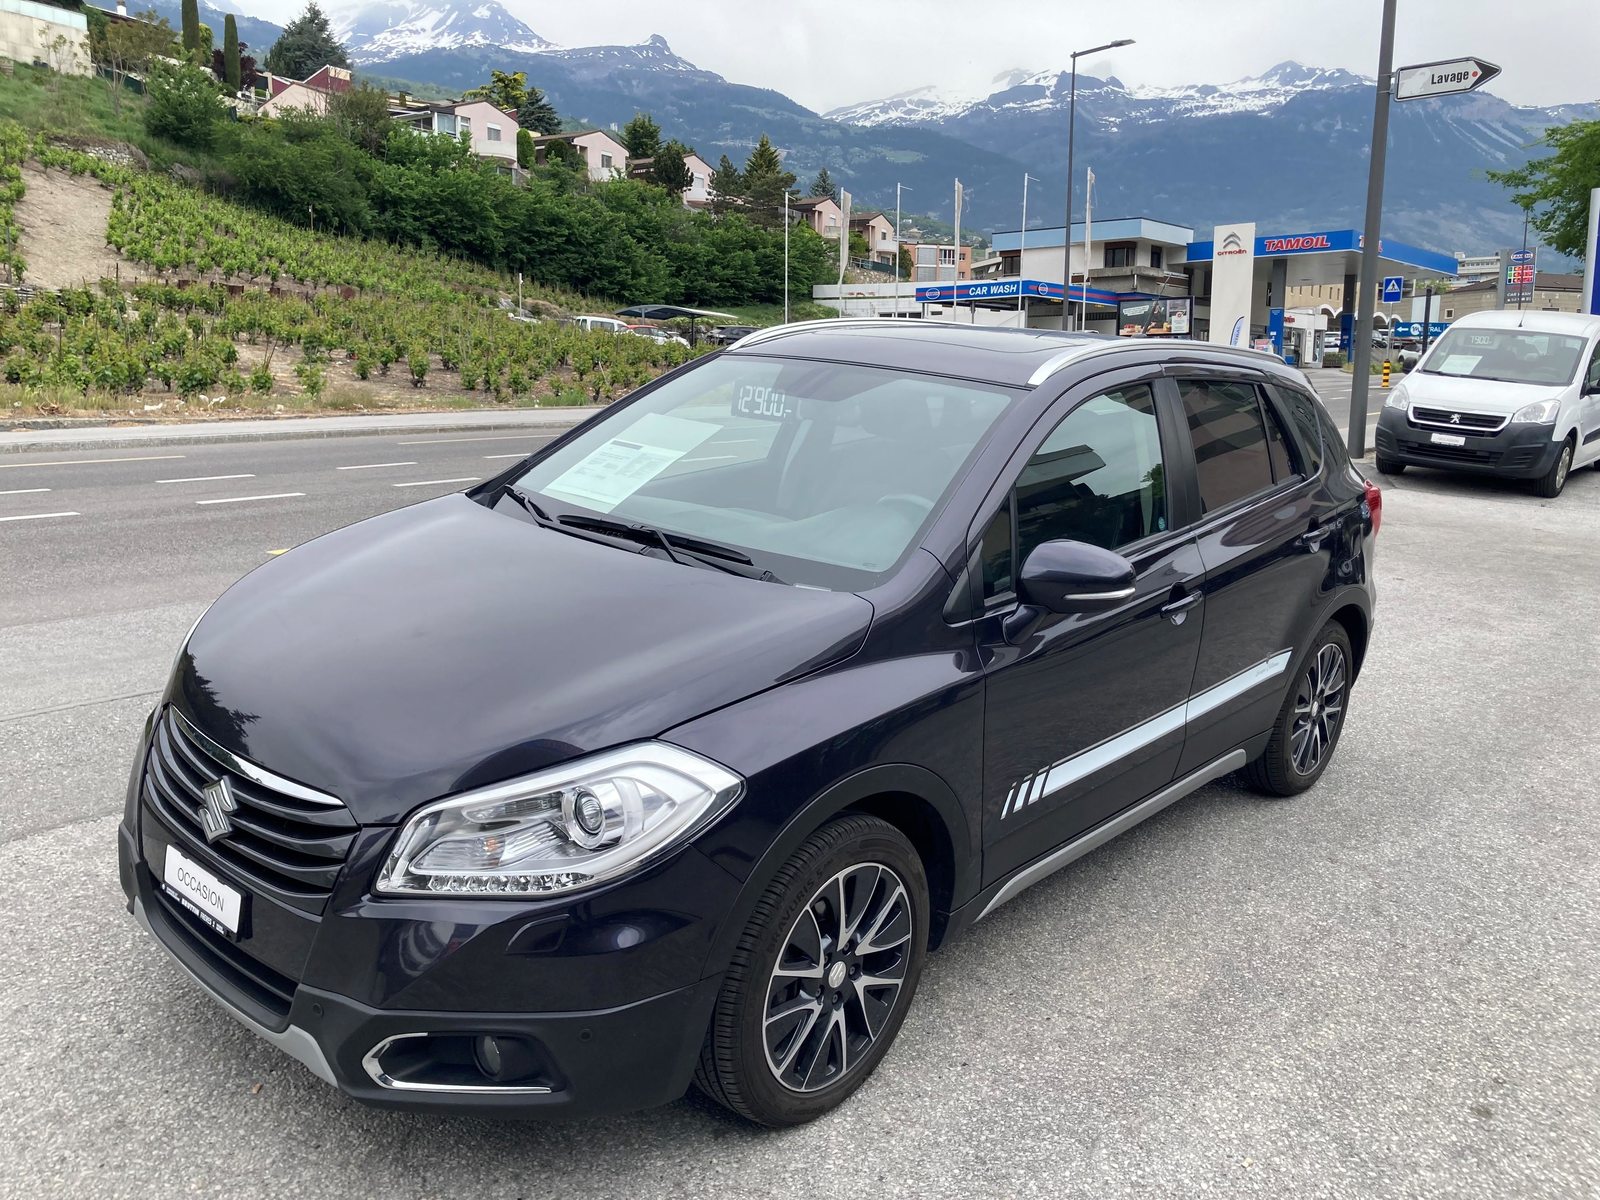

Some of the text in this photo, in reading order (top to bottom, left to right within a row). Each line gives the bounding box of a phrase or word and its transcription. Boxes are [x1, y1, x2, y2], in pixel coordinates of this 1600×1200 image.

[1431, 70, 1469, 85] Lavage
[1264, 235, 1331, 252] TAMOIL
[969, 284, 1017, 296] CAR WASH
[177, 867, 225, 912] OCCASION
